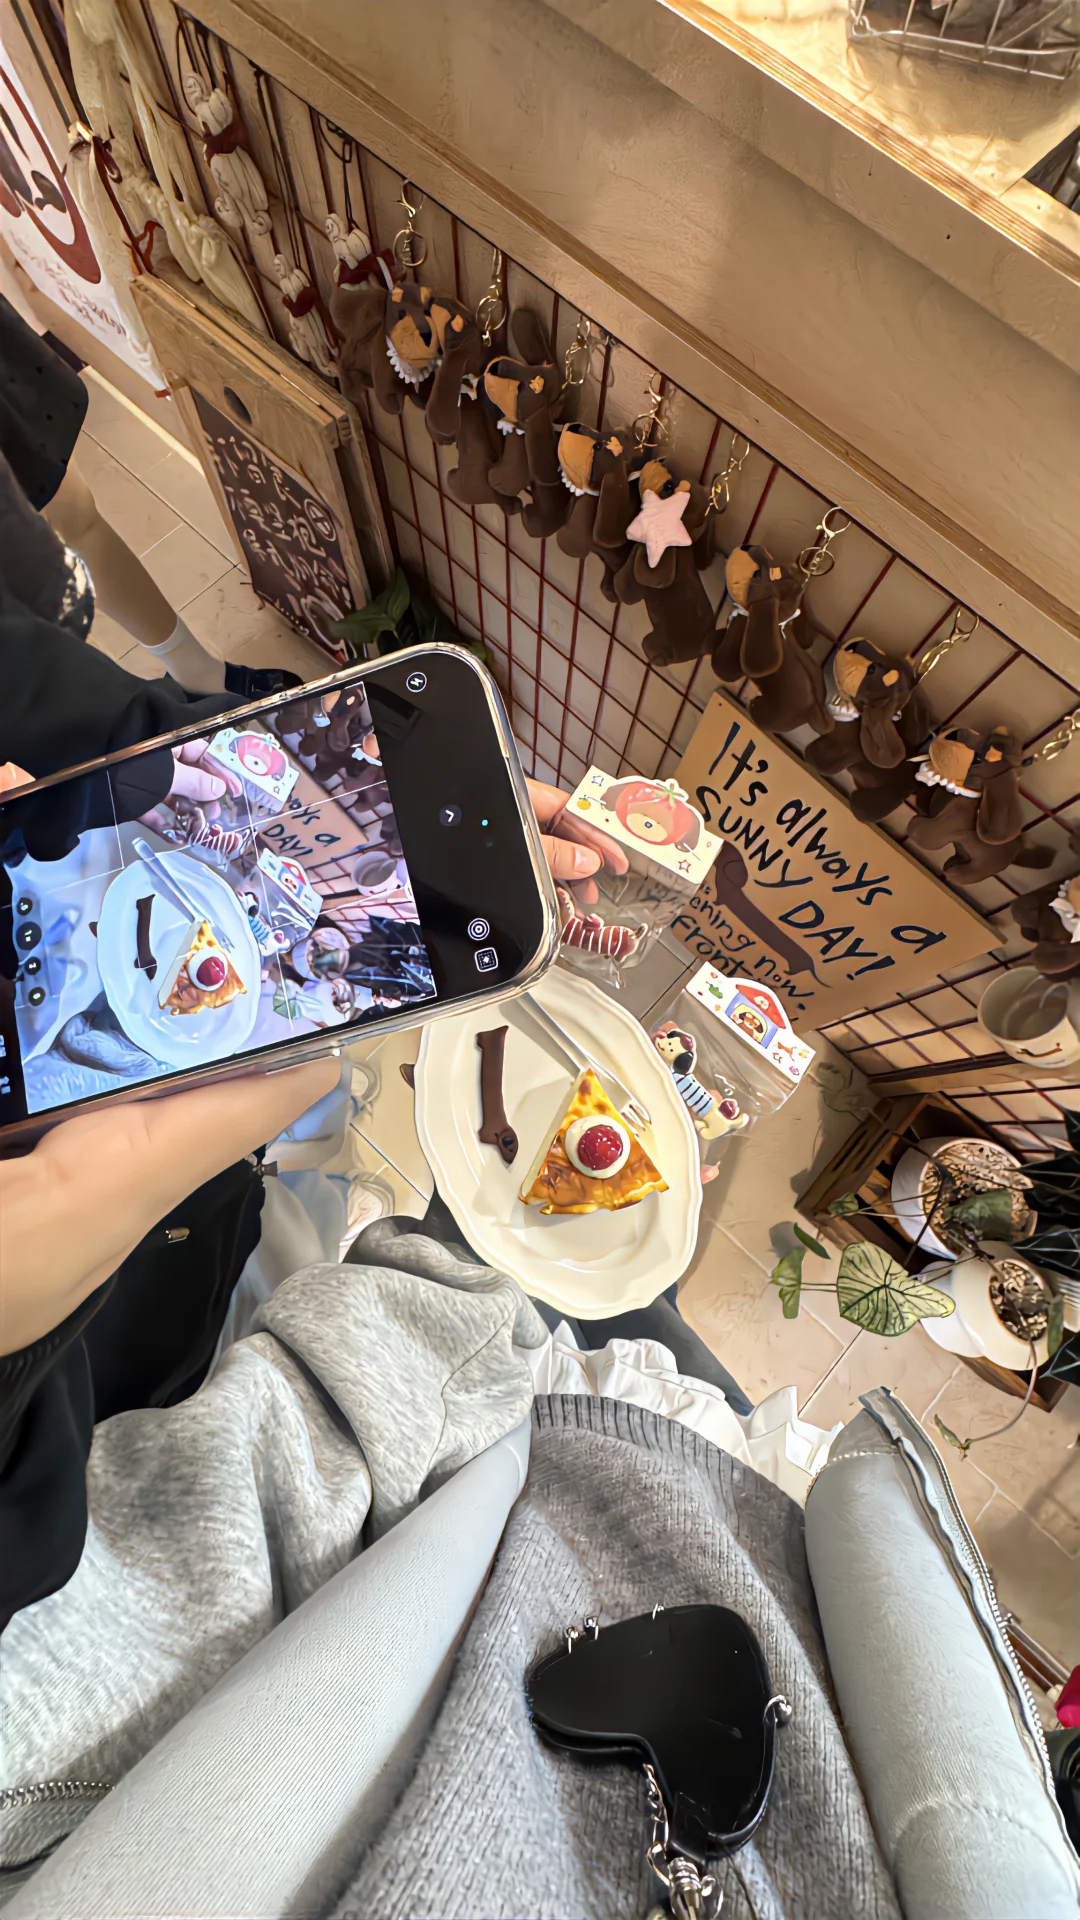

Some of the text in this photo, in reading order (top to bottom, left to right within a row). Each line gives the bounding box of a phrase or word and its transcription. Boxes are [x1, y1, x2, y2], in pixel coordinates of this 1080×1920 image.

[695, 785, 896, 981] SUNNY DAY!
[708, 721, 947, 954] It's always a
